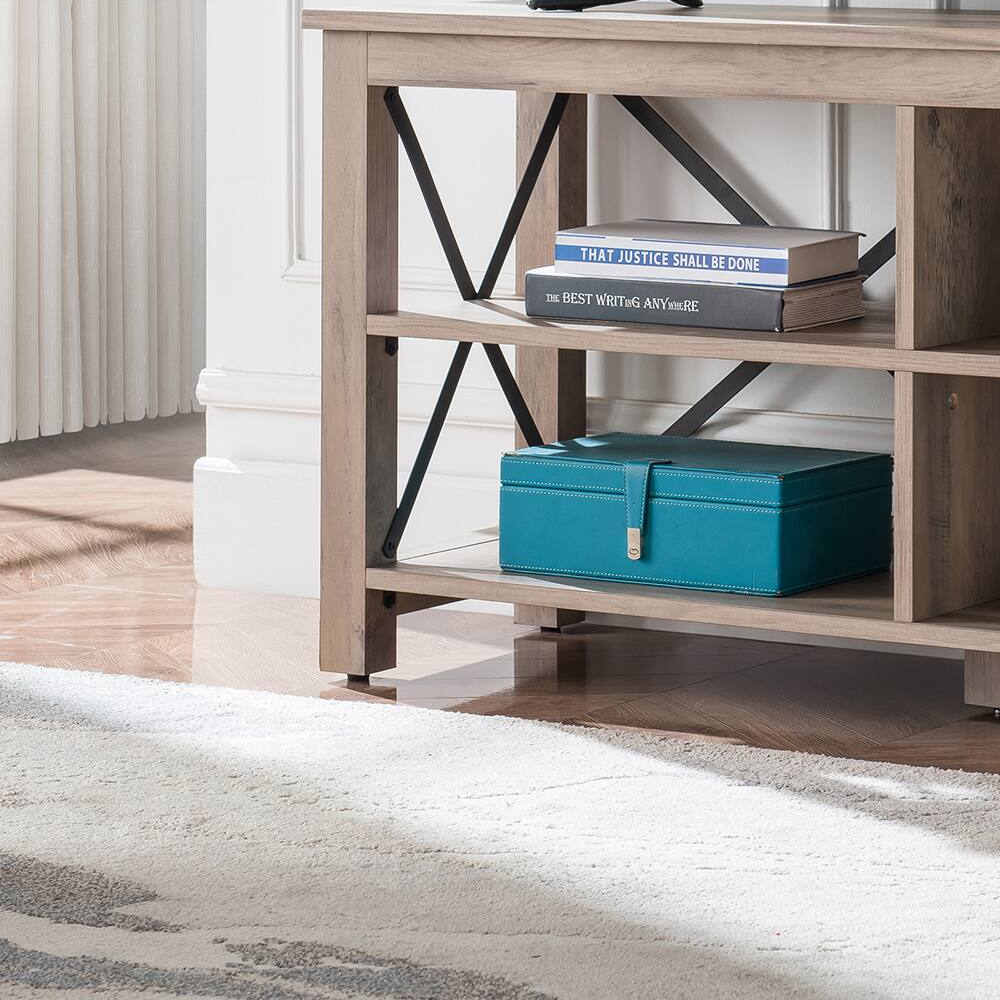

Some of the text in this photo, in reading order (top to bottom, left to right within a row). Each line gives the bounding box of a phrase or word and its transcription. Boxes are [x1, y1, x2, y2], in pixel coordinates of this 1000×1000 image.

[581, 247, 760, 271] THAT JUSTICE SHALL BE DONE
[545, 293, 560, 303] THE
[562, 291, 593, 305] BEST
